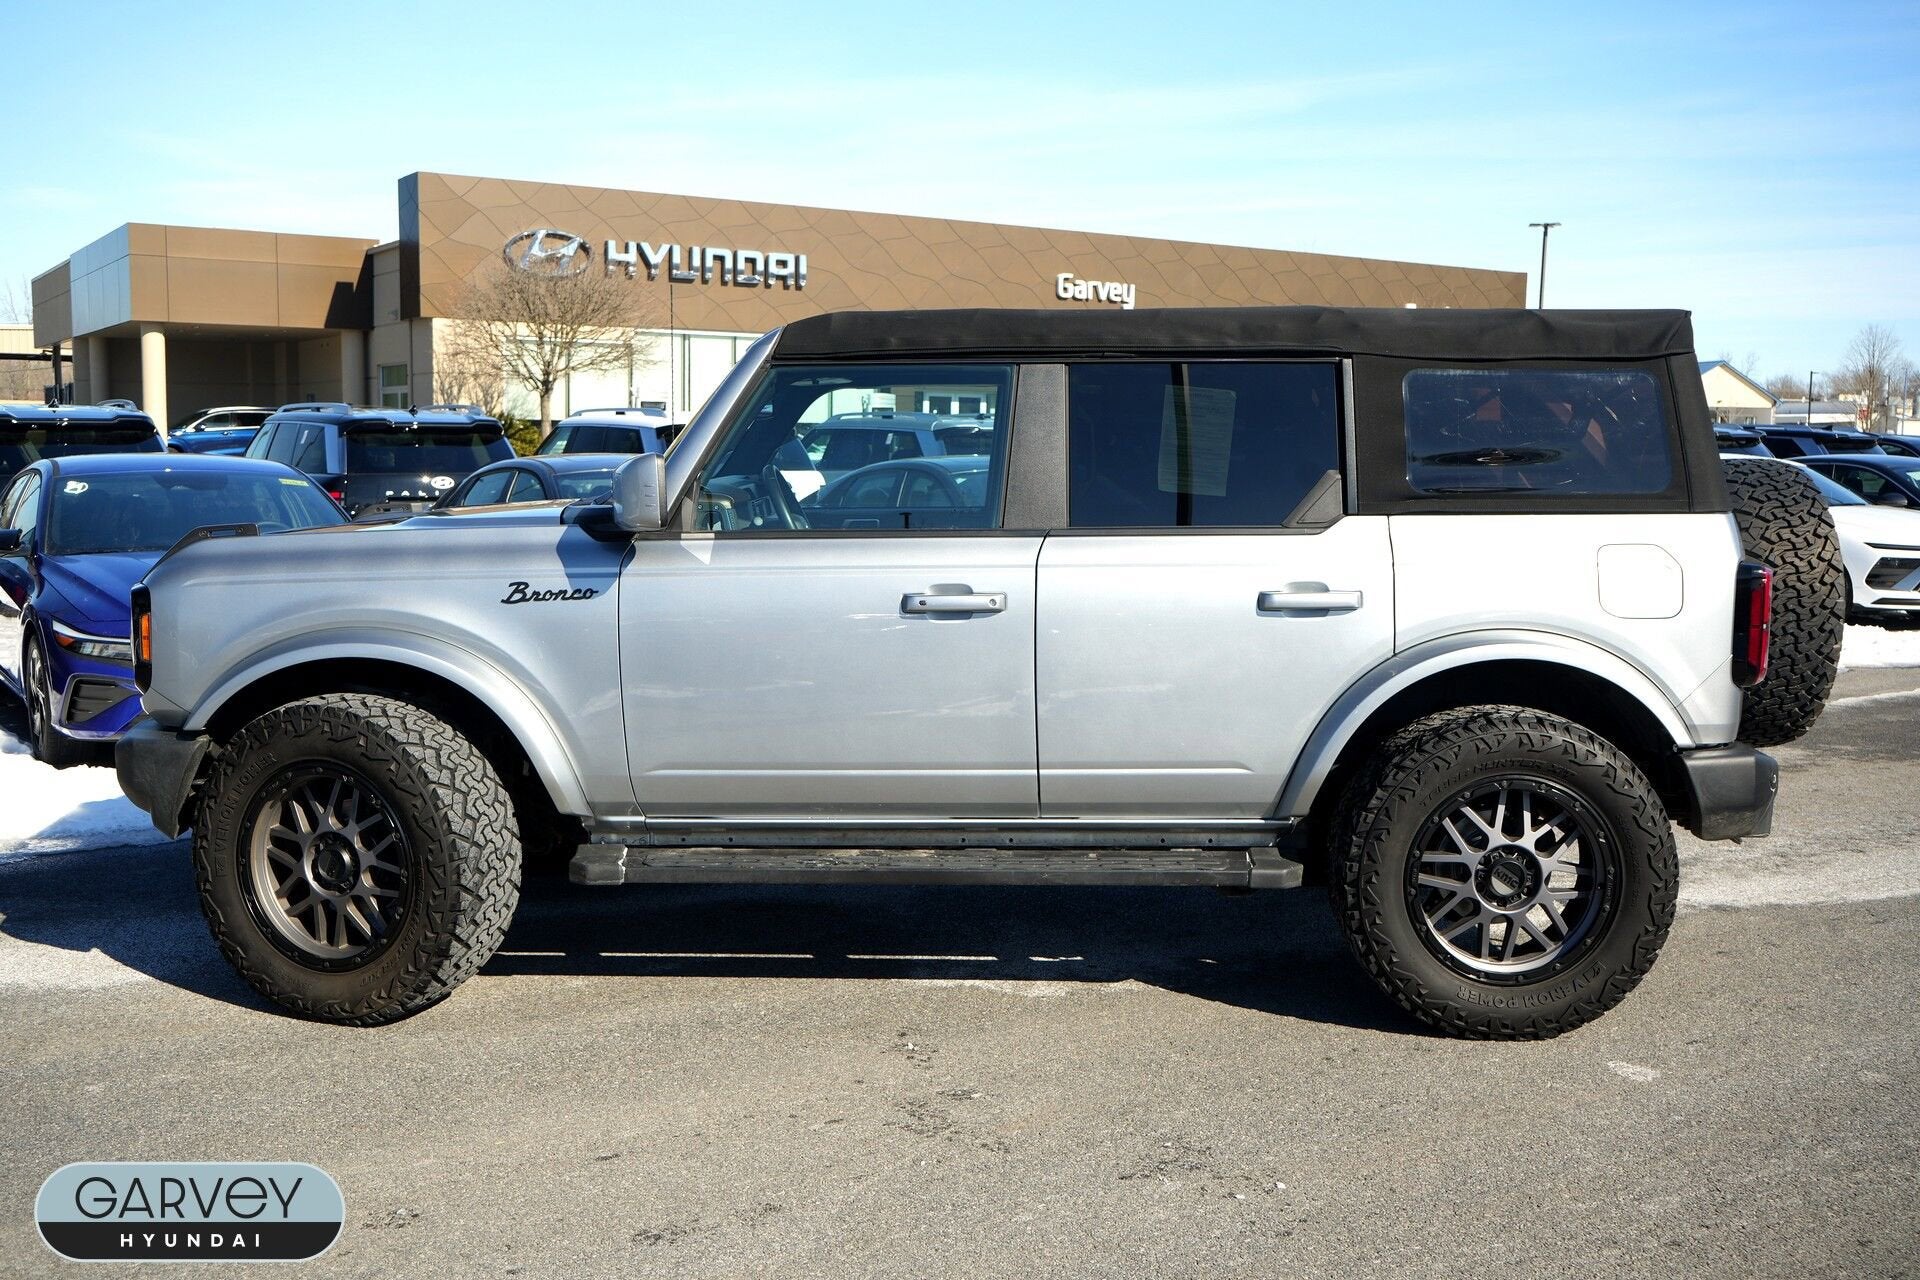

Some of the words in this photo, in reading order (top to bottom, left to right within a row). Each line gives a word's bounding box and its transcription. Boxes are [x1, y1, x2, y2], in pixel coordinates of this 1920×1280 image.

[605, 240, 808, 291] HYUNDAI
[1056, 272, 1136, 310] Garvey
[501, 581, 599, 604] Bronco
[1493, 868, 1520, 890] KMC
[1457, 986, 1519, 1008] POWER
[1523, 977, 1584, 1008] VENOM
